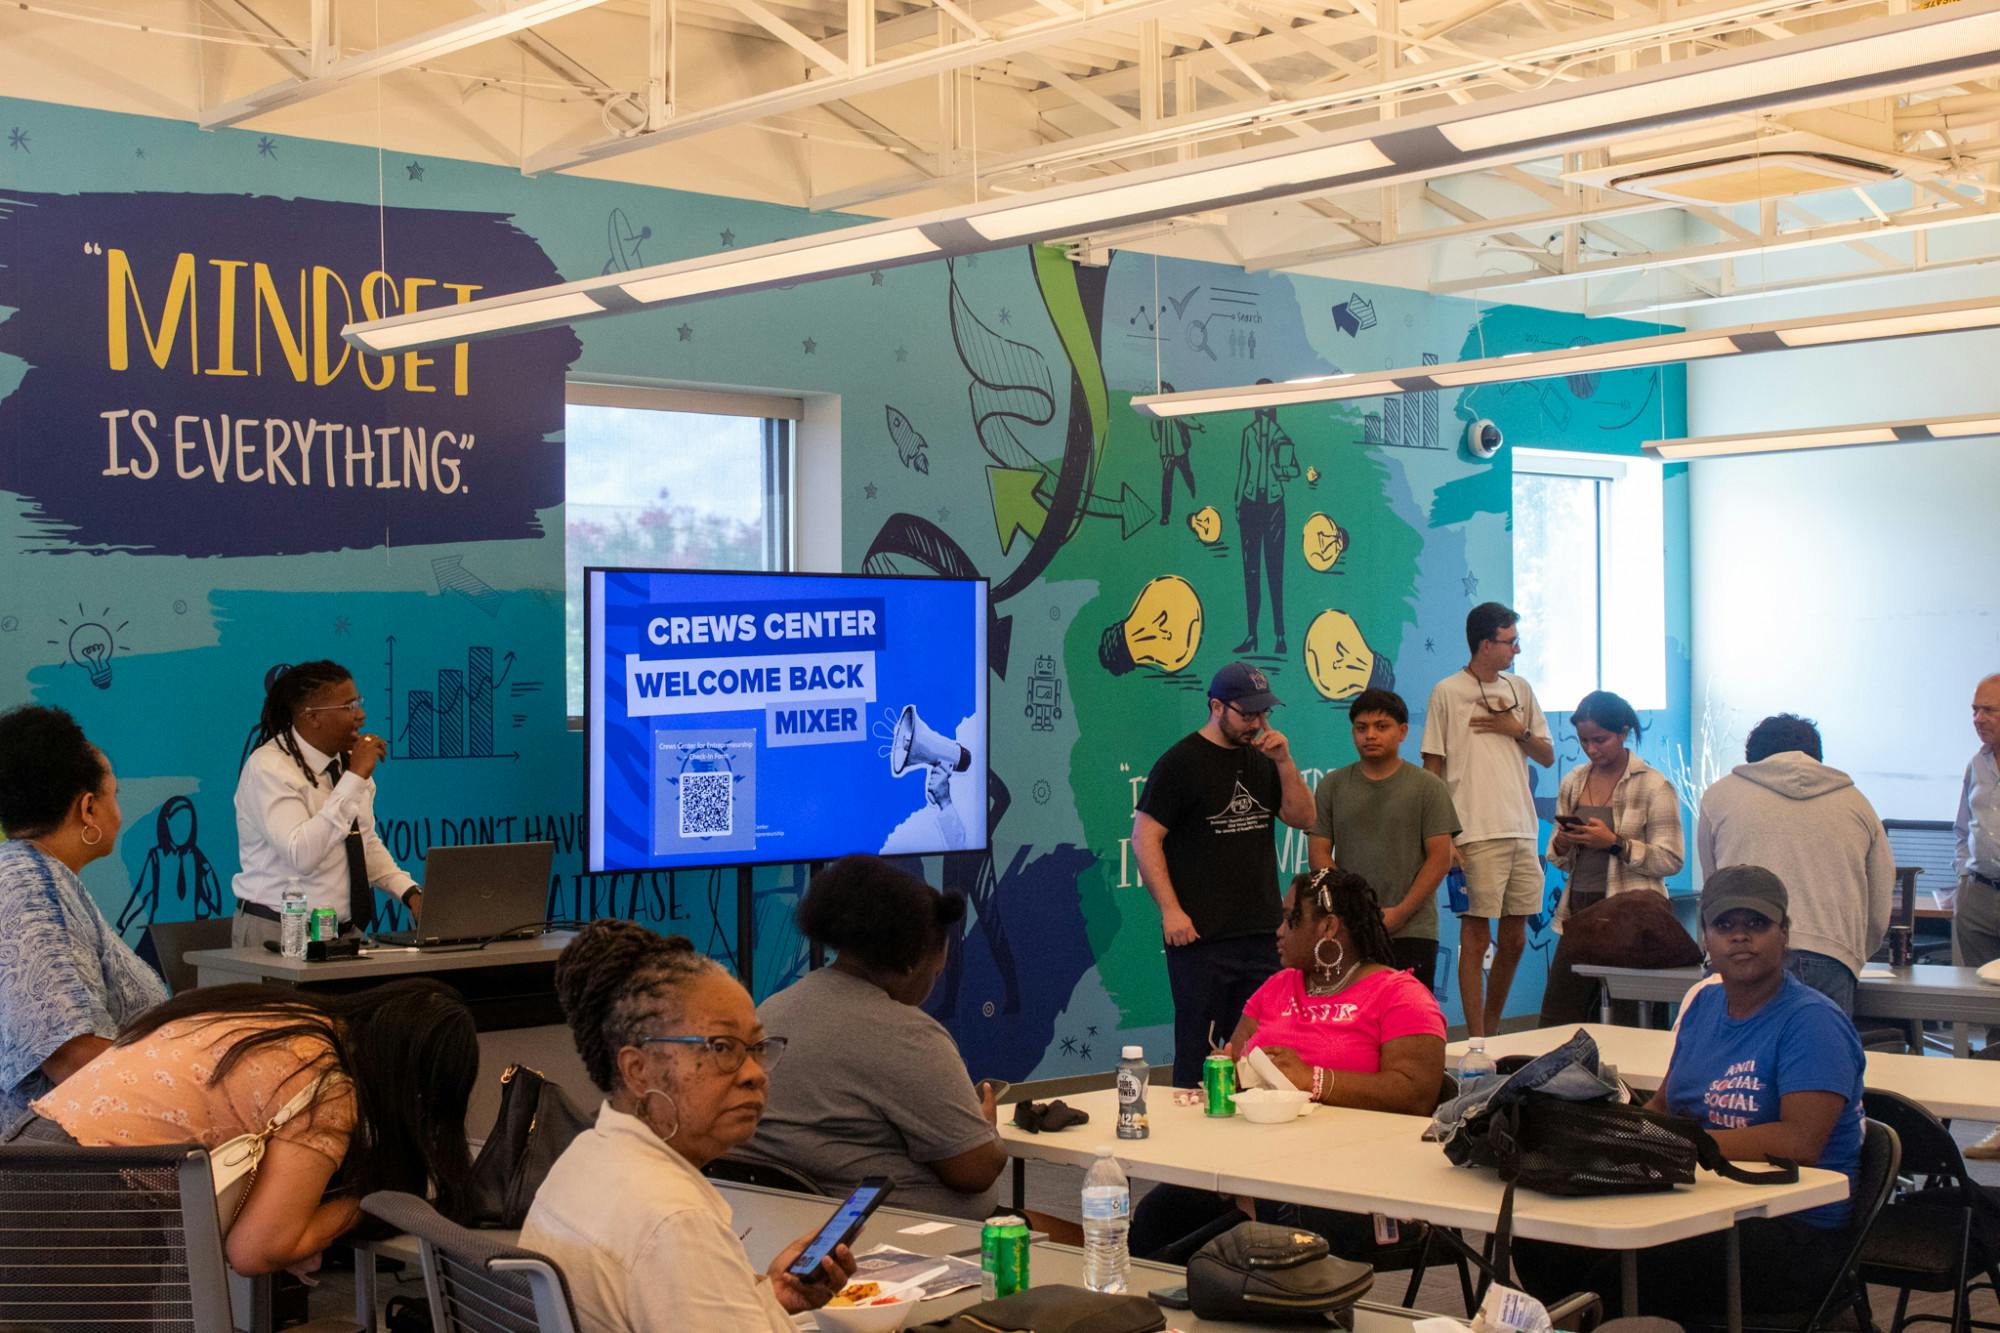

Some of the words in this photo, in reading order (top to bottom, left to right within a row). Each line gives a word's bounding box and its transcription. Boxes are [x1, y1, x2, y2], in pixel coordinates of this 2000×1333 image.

[100, 409, 158, 480] IS
[647, 613, 757, 646] CREWS
[763, 609, 877, 640] CENTER
[634, 667, 781, 699] WELCOME
[789, 663, 865, 691] BACK
[775, 708, 858, 736] MIXER
[659, 743, 676, 751] Crews
[677, 742, 696, 750] Center
[378, 817, 432, 861] YOU
[1709, 1075, 1760, 1092] SOCIAL
[1703, 1092, 1759, 1112] SOCIAL
